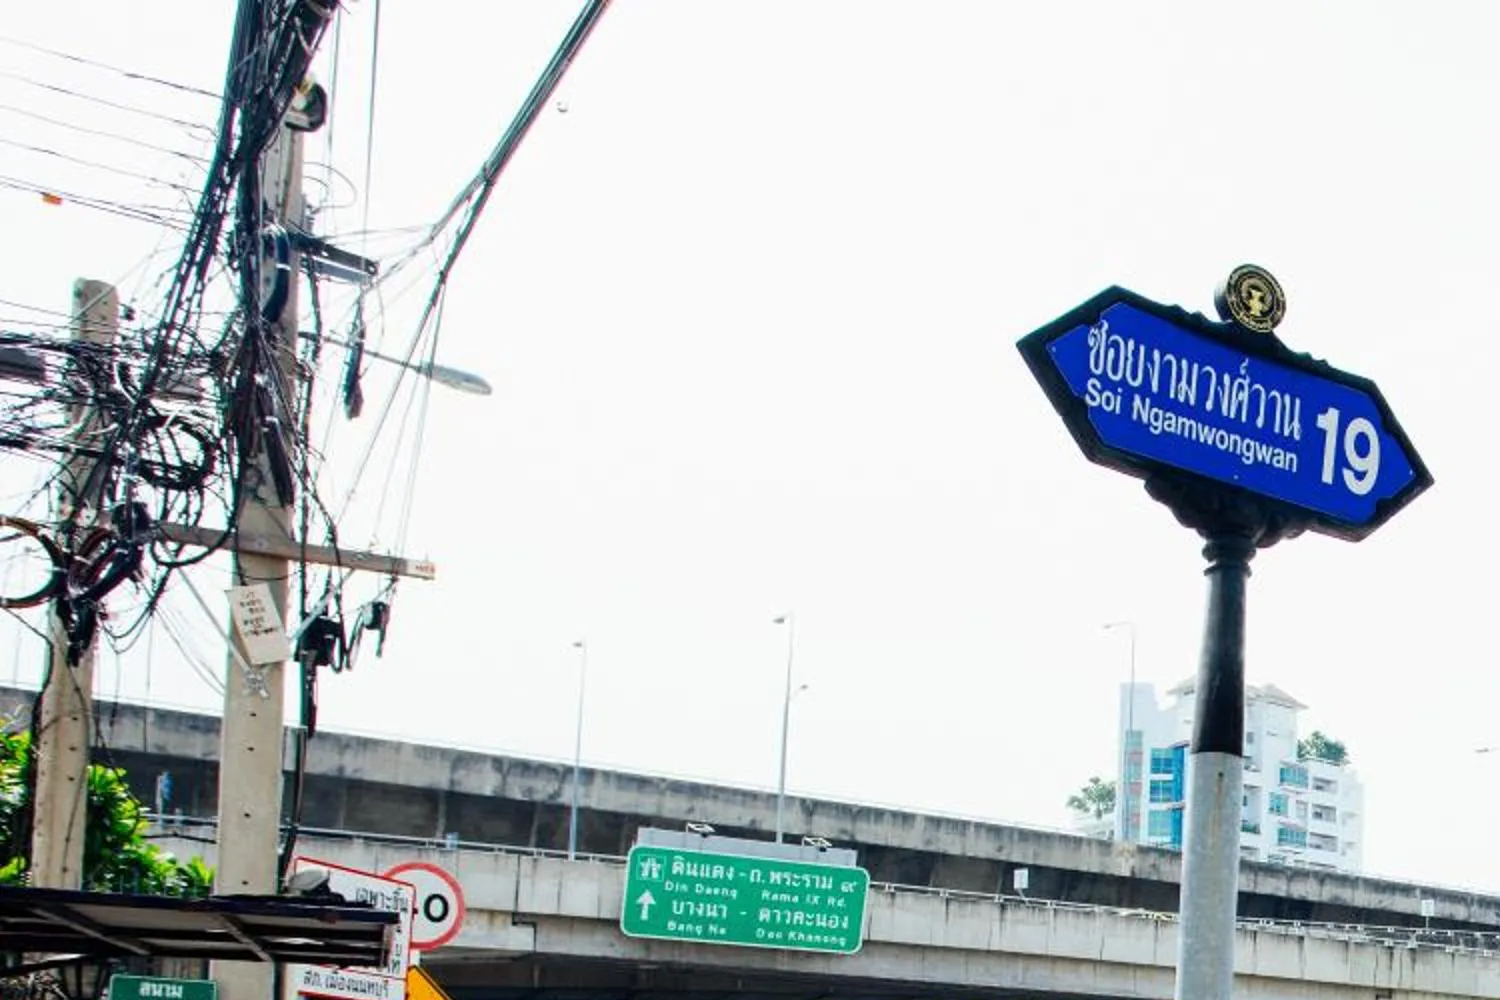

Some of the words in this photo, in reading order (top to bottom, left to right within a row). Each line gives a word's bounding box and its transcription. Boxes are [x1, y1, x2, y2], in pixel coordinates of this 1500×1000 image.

[1087, 320, 1301, 441] ซอยงามวงศ์วาน
[1085, 379, 1122, 416] Soi
[1132, 398, 1298, 473] Ngamwongwan
[1316, 407, 1381, 496] 19
[665, 881, 688, 893] Din
[695, 884, 737, 900] Daeng
[761, 889, 799, 903] Rama
[672, 900, 728, 919] บางนา
[667, 920, 702, 936] Bang
[708, 923, 727, 935] Na
[139, 982, 184, 999] สนาม
